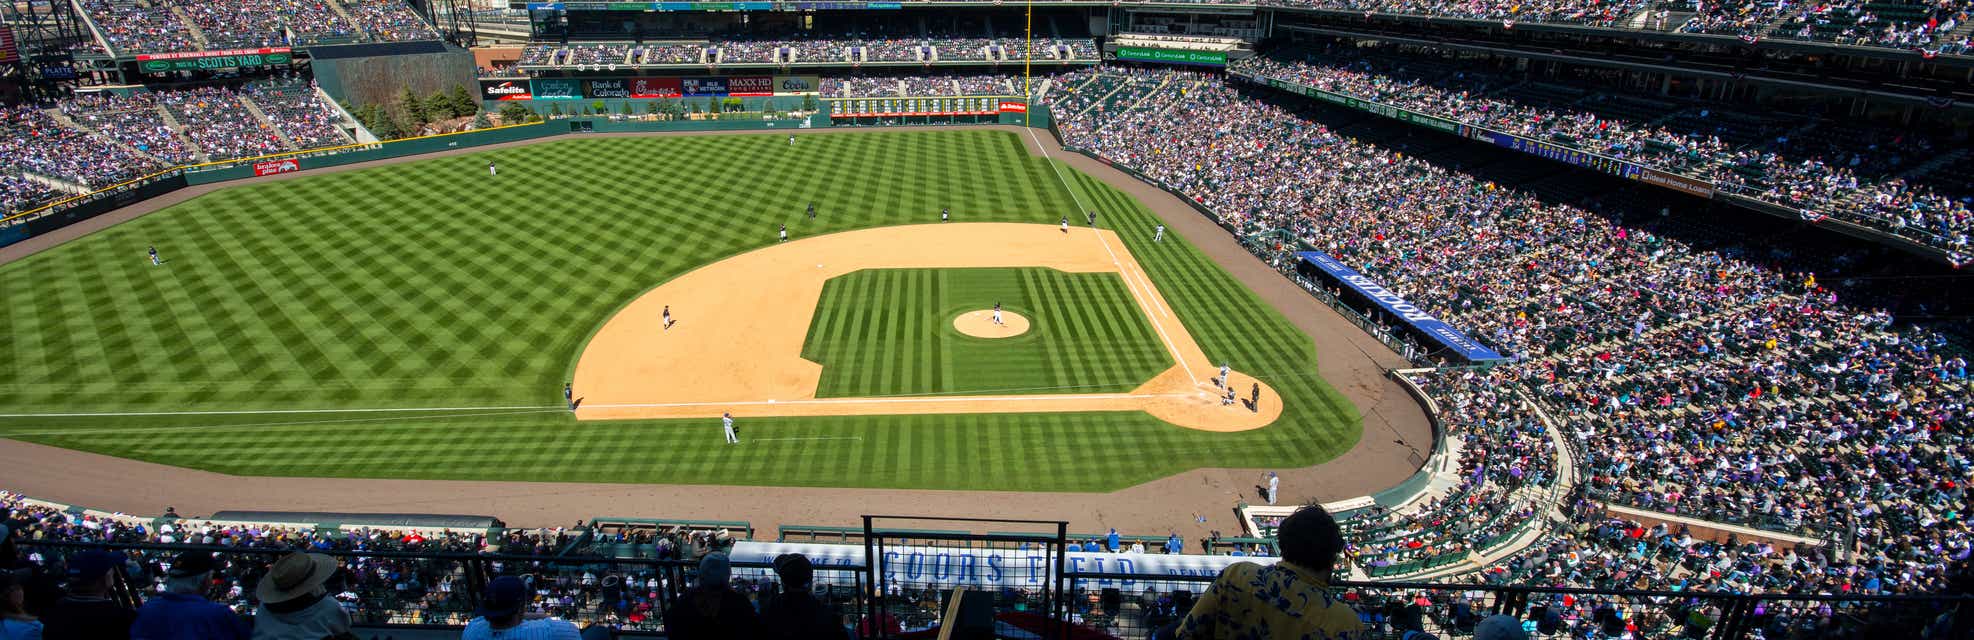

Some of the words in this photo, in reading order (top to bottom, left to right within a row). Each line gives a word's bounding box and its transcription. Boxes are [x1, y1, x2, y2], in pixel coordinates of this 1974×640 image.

[199, 55, 236, 69] SCOTTS
[238, 54, 262, 66] YARD
[592, 80, 611, 89] Bank
[613, 80, 621, 88] of
[783, 80, 809, 90] Coors
[487, 86, 525, 94] Safelite
[593, 89, 630, 98] Colorado
[1667, 178, 1688, 188] Home
[1342, 273, 1437, 322] ROCKIES
[883, 551, 1001, 587] COORS
